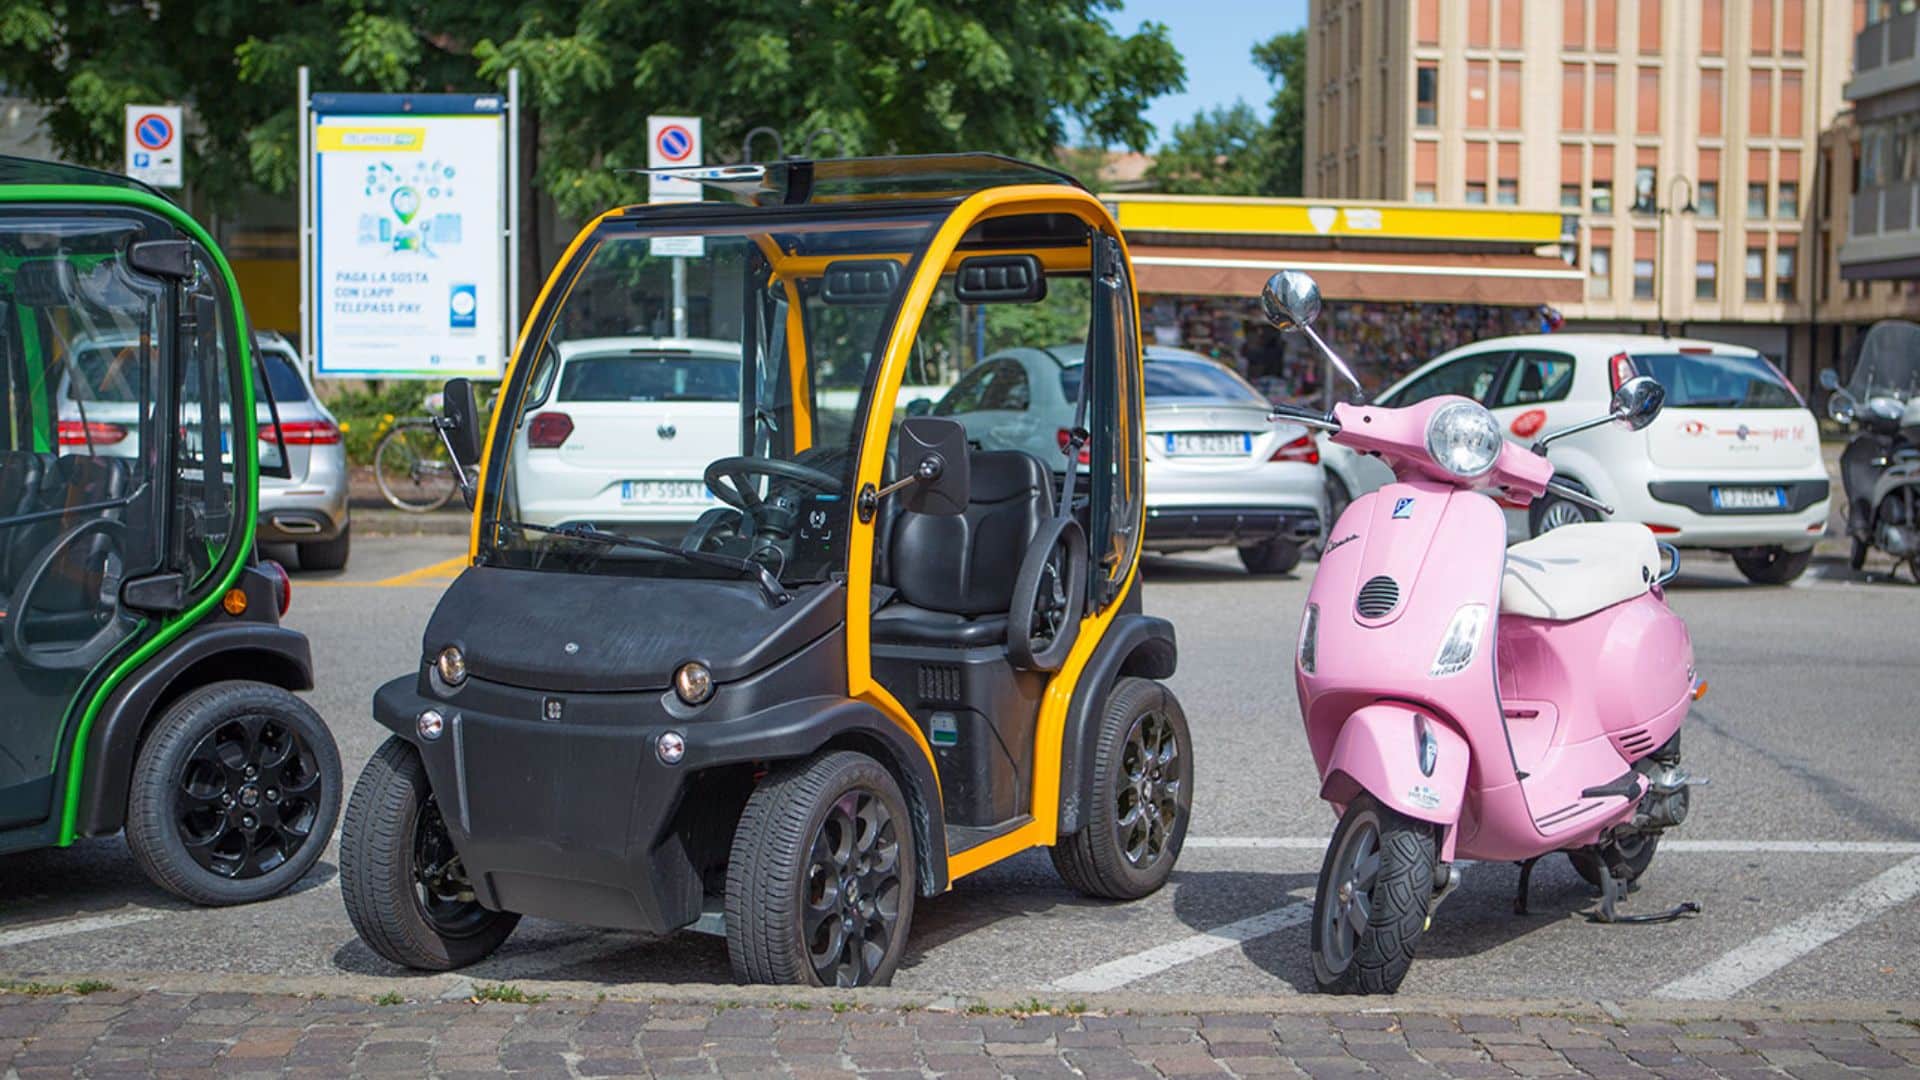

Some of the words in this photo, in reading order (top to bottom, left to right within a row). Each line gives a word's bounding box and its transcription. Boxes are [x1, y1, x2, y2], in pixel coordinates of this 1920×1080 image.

[336, 272, 368, 282] PAGA
[371, 272, 387, 282] LA
[390, 272, 429, 282] SOSTA
[334, 287, 359, 298] CON
[334, 302, 395, 313] TELEPASS
